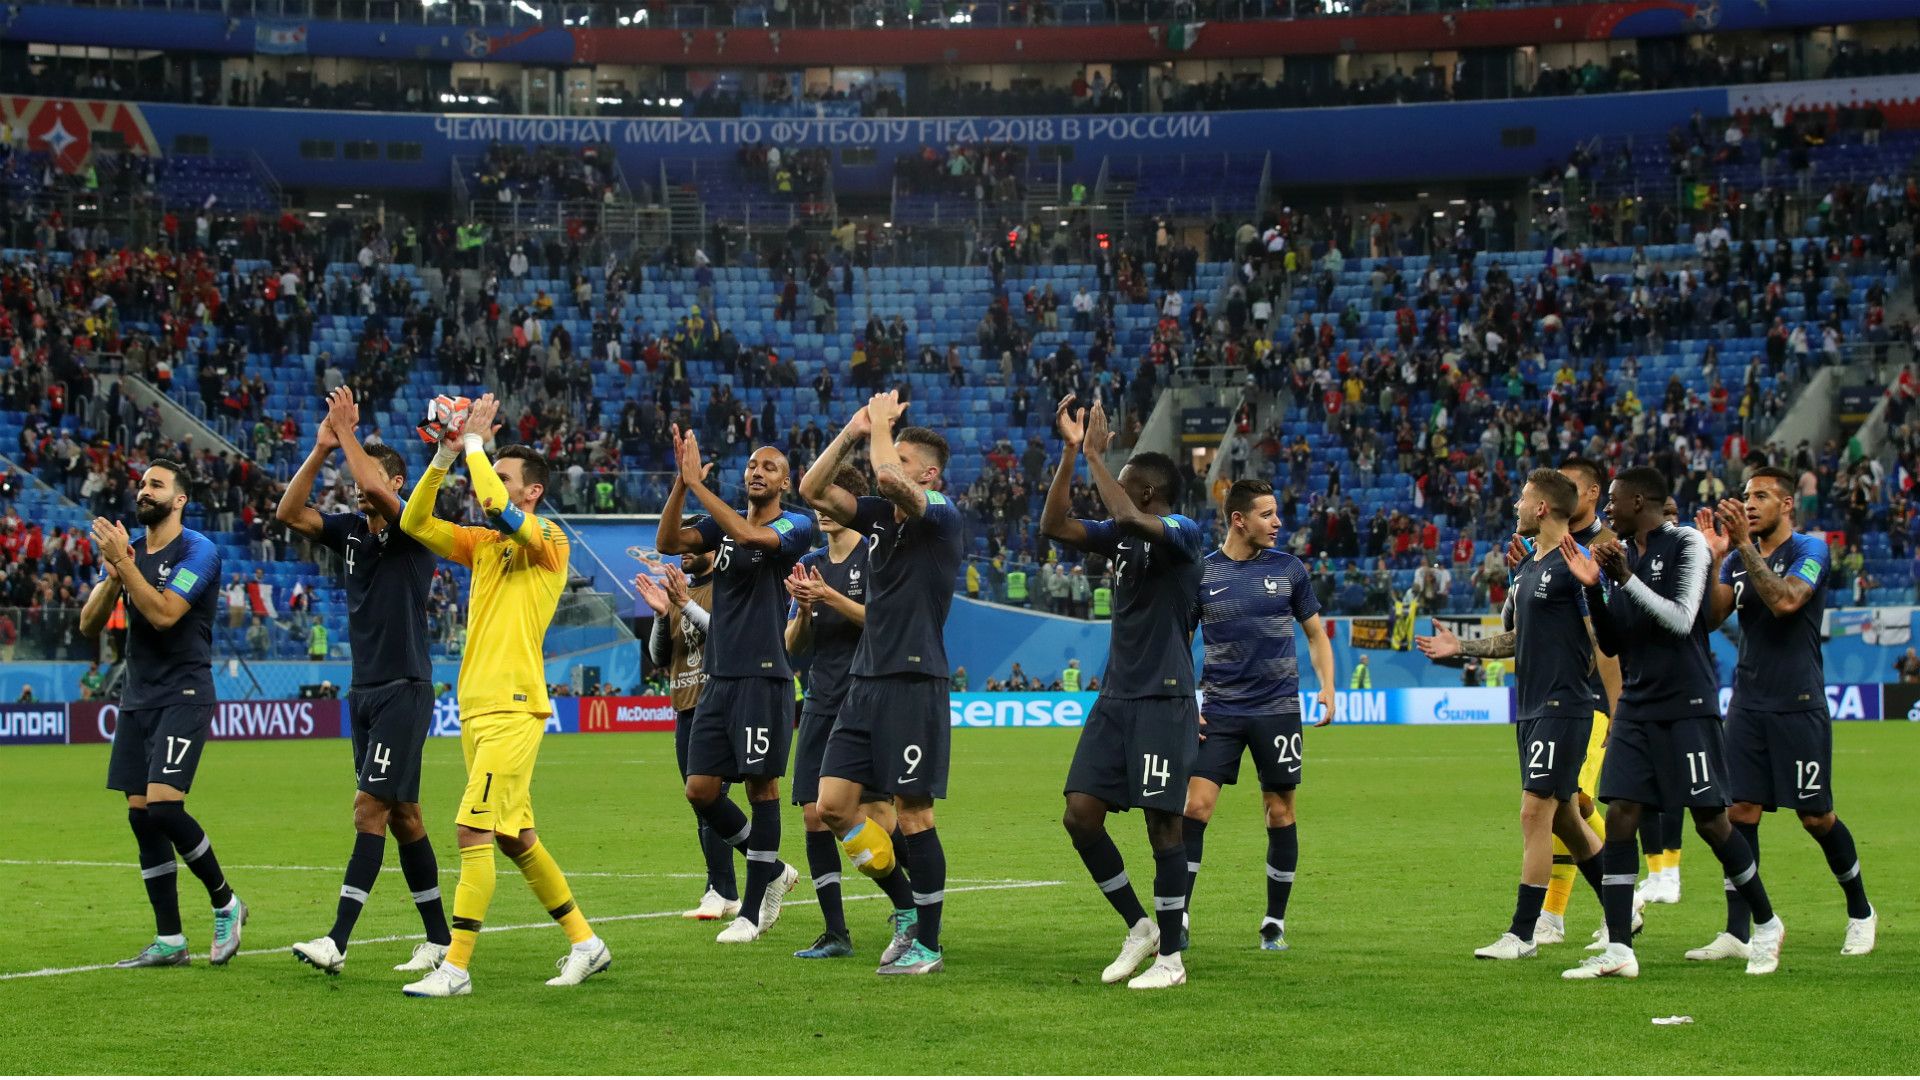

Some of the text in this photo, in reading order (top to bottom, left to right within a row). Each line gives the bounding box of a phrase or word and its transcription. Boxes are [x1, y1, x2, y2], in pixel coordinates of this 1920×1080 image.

[434, 118, 616, 141] ЧЕМПИОНАТ
[625, 121, 712, 143] МИРА
[720, 121, 762, 143] ПО
[770, 121, 909, 143] ФУТБОЛУ
[919, 119, 979, 142] FIFA
[987, 119, 1054, 142] 2018
[1088, 115, 1210, 140] РОССИИ
[346, 544, 355, 575] 4
[713, 543, 734, 571] 15
[166, 736, 191, 765] 17
[745, 727, 769, 754] 15
[1274, 733, 1302, 763] 20
[1528, 740, 1556, 770] 21
[373, 743, 391, 774] 4
[903, 744, 922, 774] 9
[1143, 753, 1170, 787] 14
[1687, 751, 1709, 783] 11
[483, 772, 493, 802] 1
[1795, 760, 1821, 790] 12
